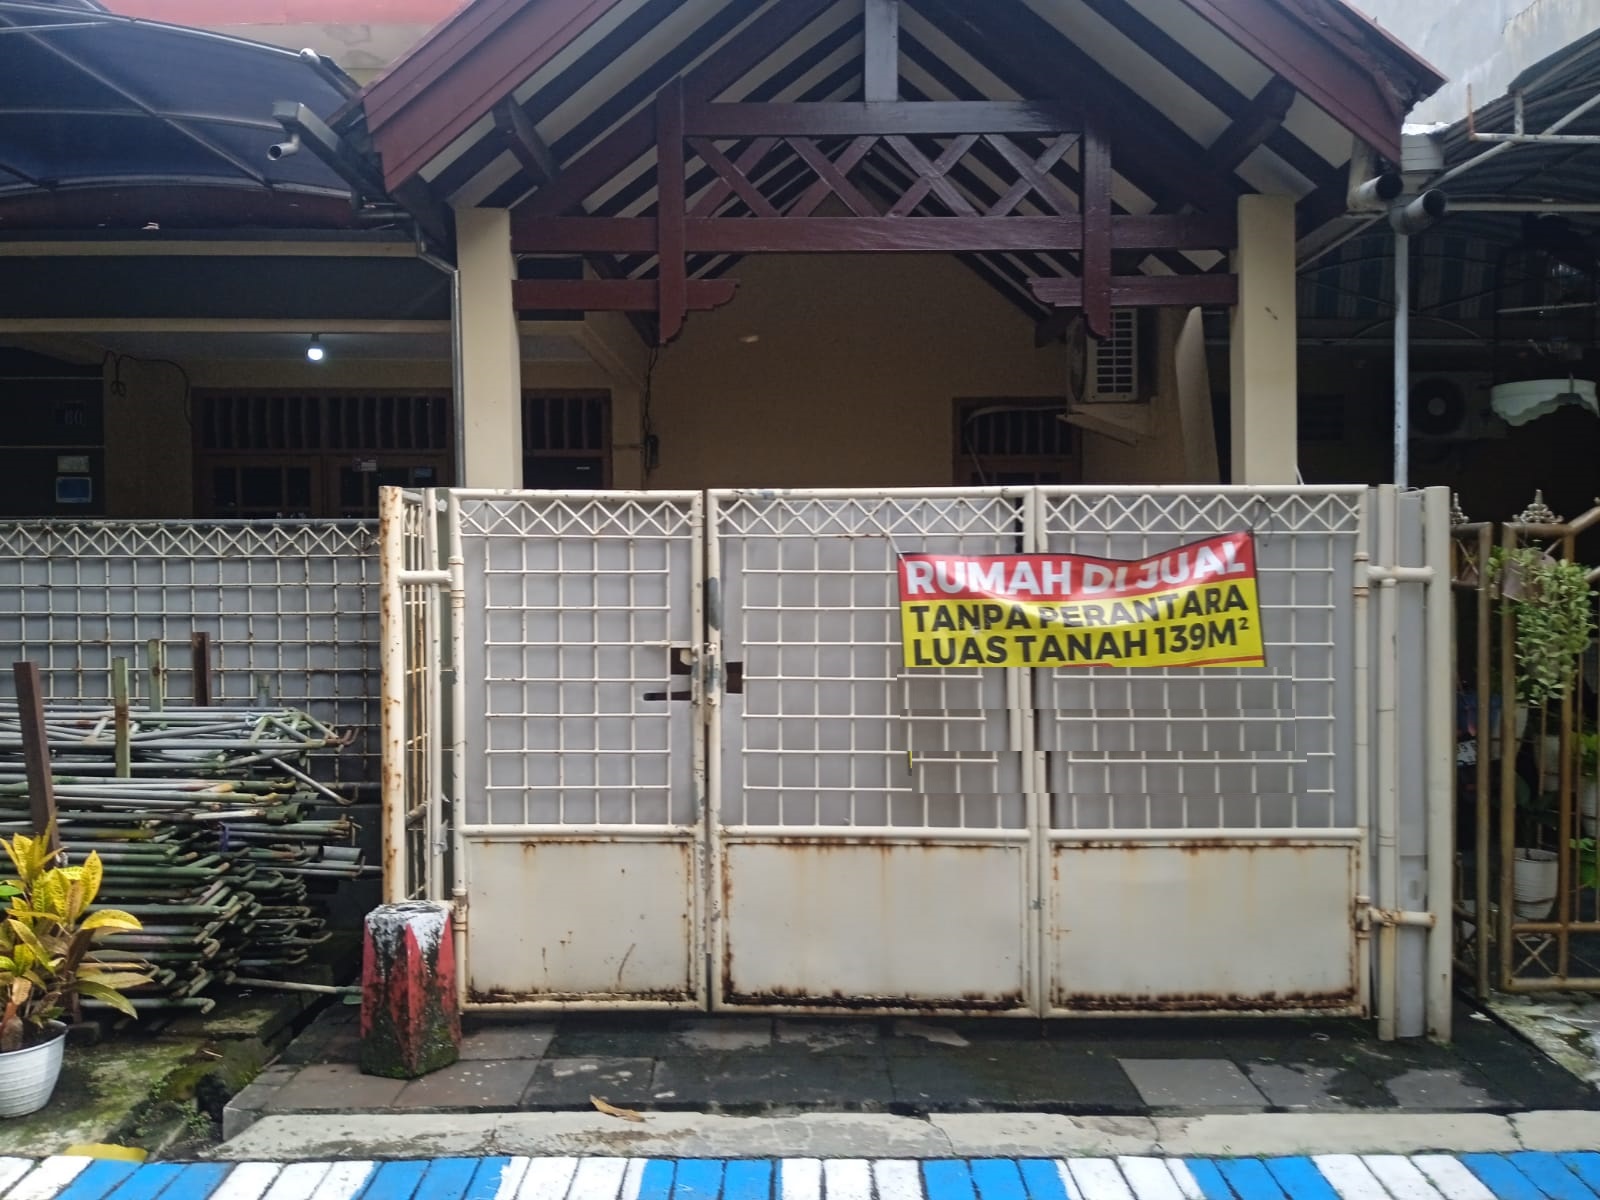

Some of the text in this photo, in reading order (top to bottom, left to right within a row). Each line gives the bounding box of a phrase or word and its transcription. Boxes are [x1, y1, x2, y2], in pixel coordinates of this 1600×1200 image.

[905, 540, 1246, 596] RUMAH DI JUAL
[910, 585, 1248, 633] TANPA PERANTARA
[913, 635, 1007, 666] LUAS
[1014, 629, 1147, 663] TANAH
